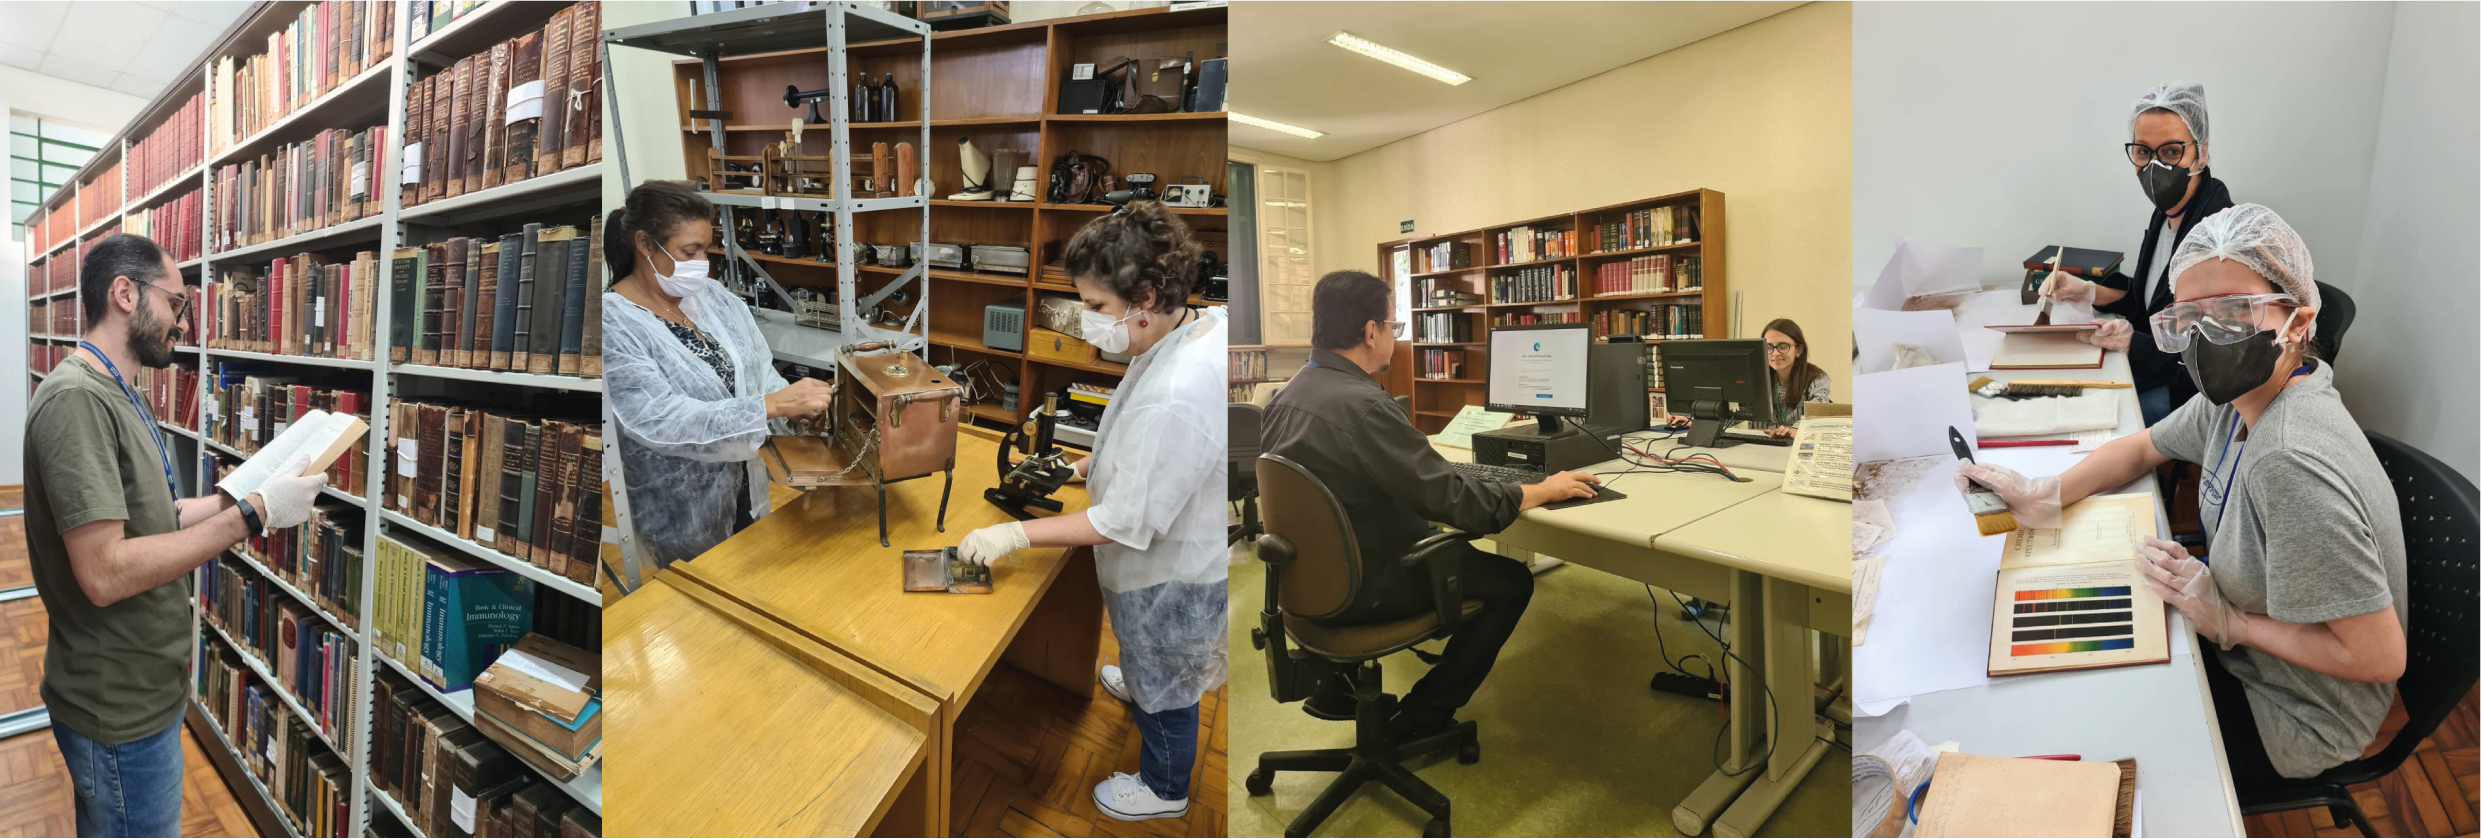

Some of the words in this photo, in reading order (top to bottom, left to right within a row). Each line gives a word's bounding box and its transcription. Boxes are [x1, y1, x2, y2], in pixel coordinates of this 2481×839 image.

[2014, 528, 2026, 551] CHEMIC
[466, 610, 521, 622] Immunology
[498, 603, 522, 611] Clinical
[423, 600, 434, 656] Immunology
[435, 607, 446, 664] Immunology
